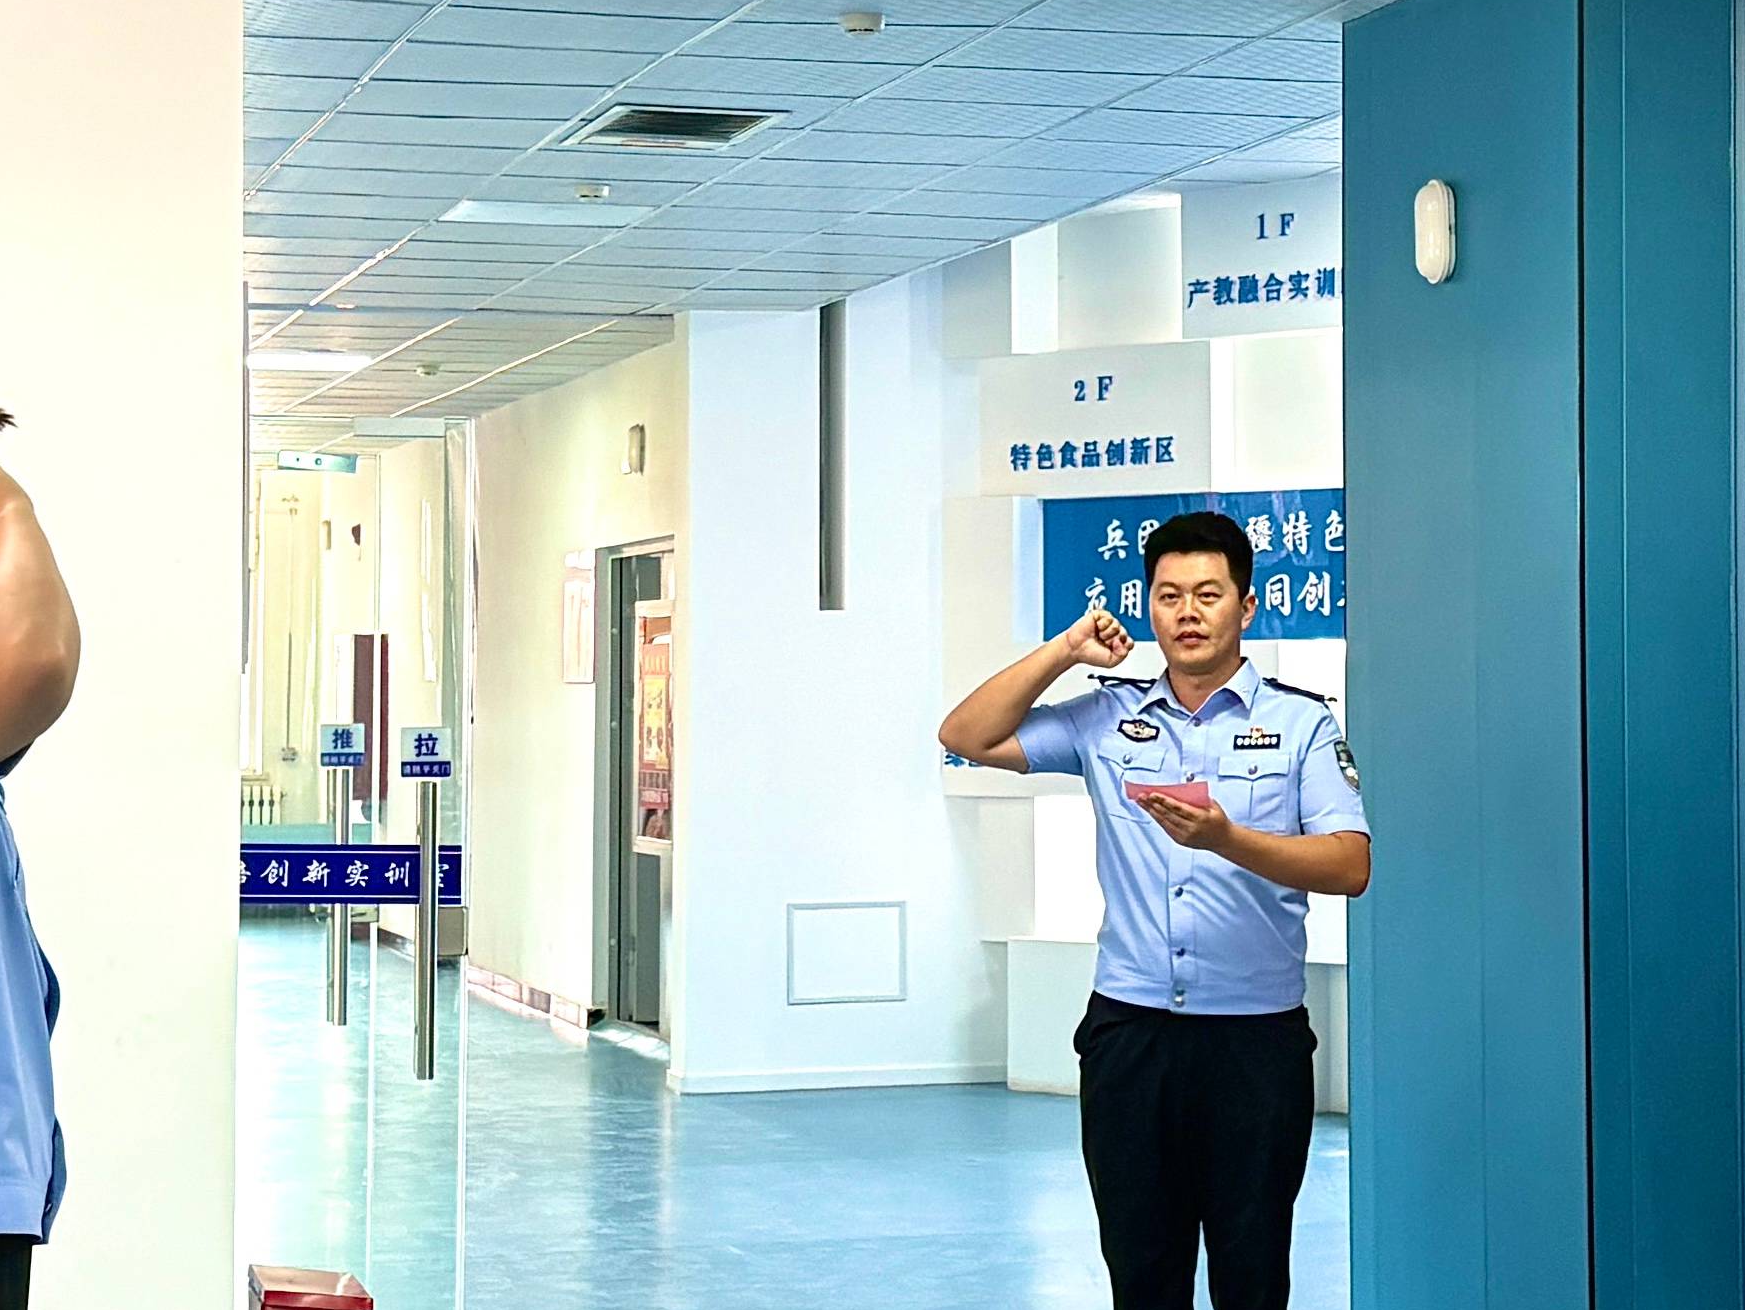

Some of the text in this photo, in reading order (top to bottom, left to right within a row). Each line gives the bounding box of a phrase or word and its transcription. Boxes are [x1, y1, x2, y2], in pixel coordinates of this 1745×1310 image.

[1187, 267, 1343, 309] 产教融合实训
[1010, 435, 1175, 472] 特色食品创新区
[332, 728, 353, 749] 推
[414, 733, 438, 757] 拉
